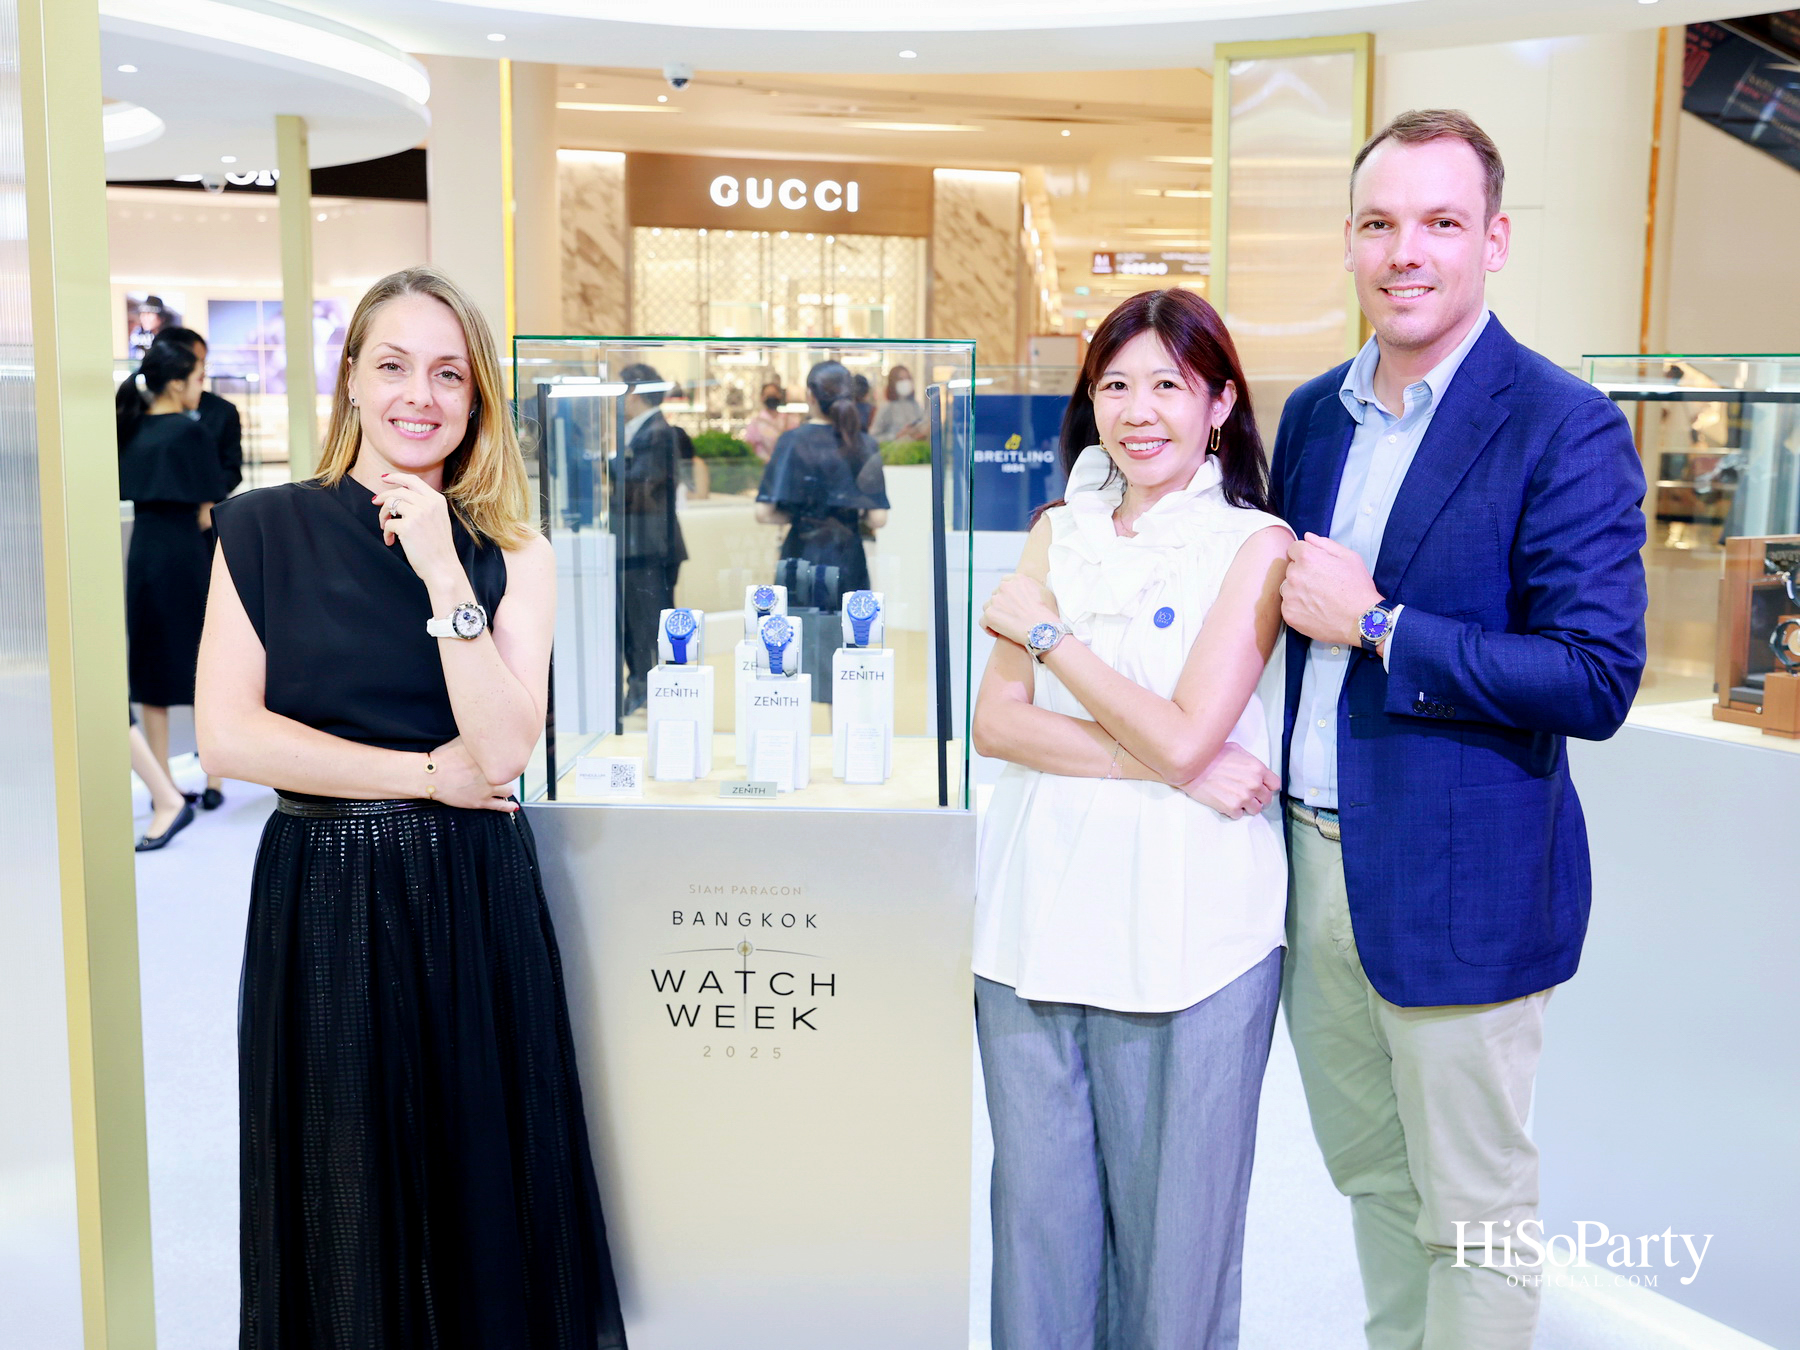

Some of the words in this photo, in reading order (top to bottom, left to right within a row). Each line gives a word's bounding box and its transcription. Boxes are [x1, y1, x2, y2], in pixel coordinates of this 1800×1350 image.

[709, 175, 859, 213] GUCCI
[974, 450, 1055, 463] BREITLING
[840, 670, 885, 681] ZENITH
[655, 687, 699, 698] ZENITH
[754, 696, 799, 707] ZENITH
[689, 884, 724, 895] SIAM
[731, 885, 802, 896] PARAGON
[672, 910, 817, 929] BANGKOK
[651, 968, 836, 997] WATCH
[666, 1003, 819, 1031] WEEK
[703, 1045, 782, 1059] 2025
